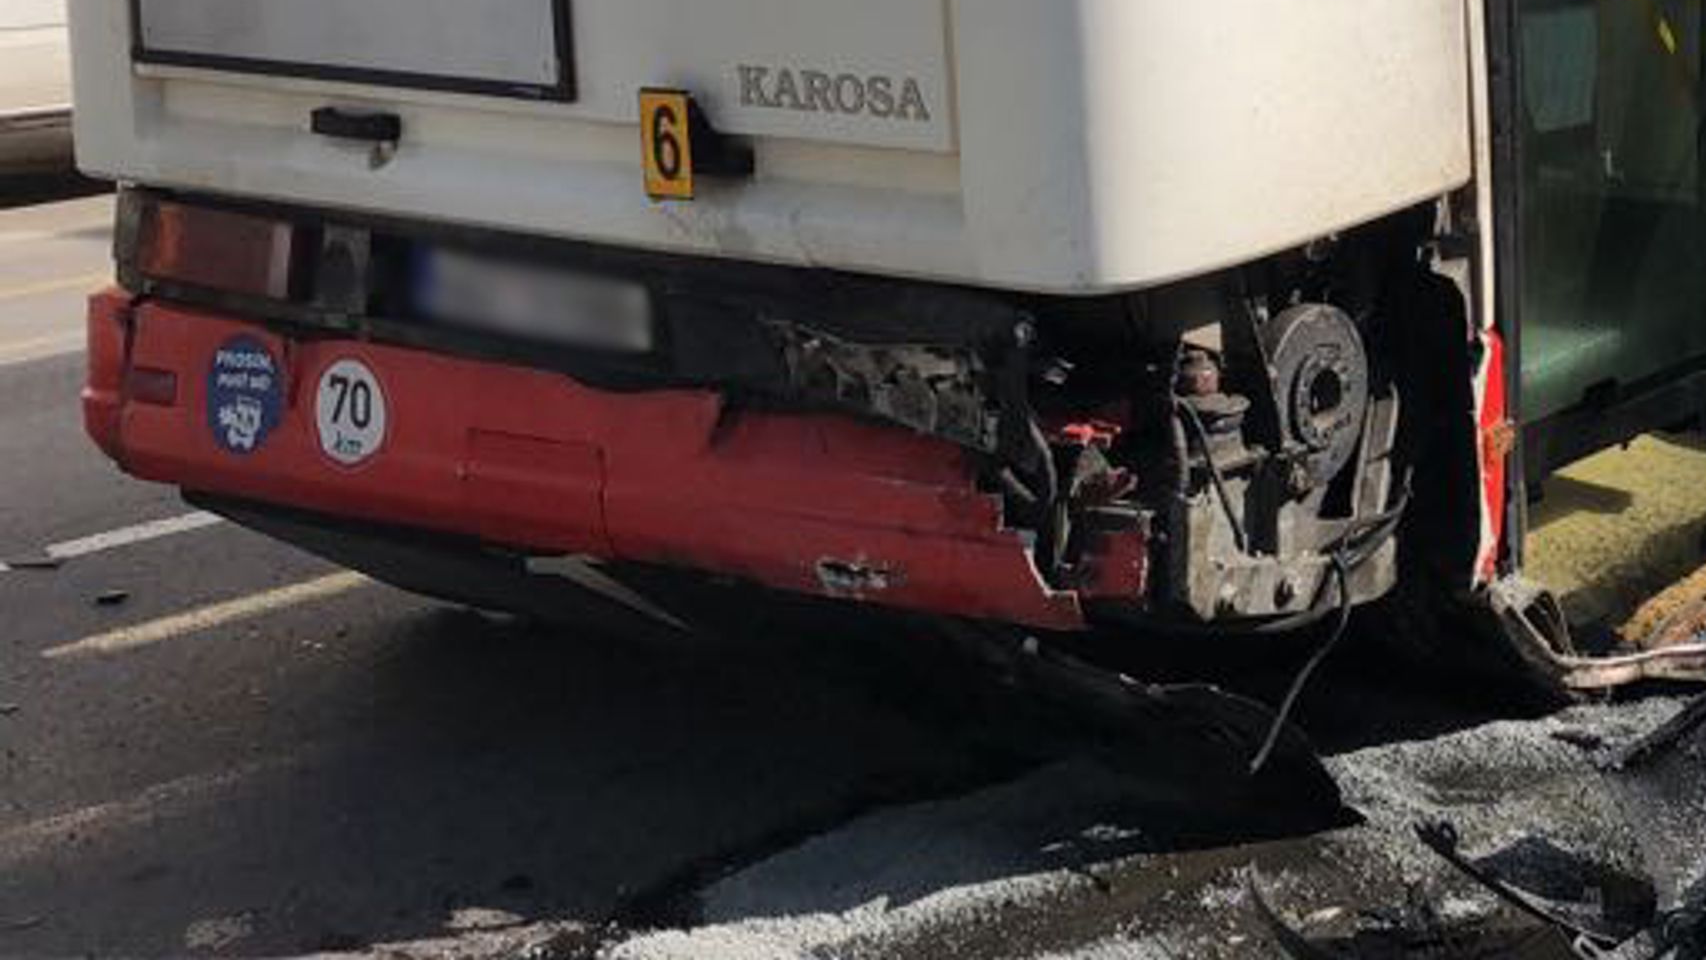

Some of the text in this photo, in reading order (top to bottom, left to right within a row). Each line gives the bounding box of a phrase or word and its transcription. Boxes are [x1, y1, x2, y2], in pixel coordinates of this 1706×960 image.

[736, 63, 931, 122] KAROSA
[652, 104, 682, 182] 6
[330, 373, 372, 430] 70
[334, 430, 363, 455] km
